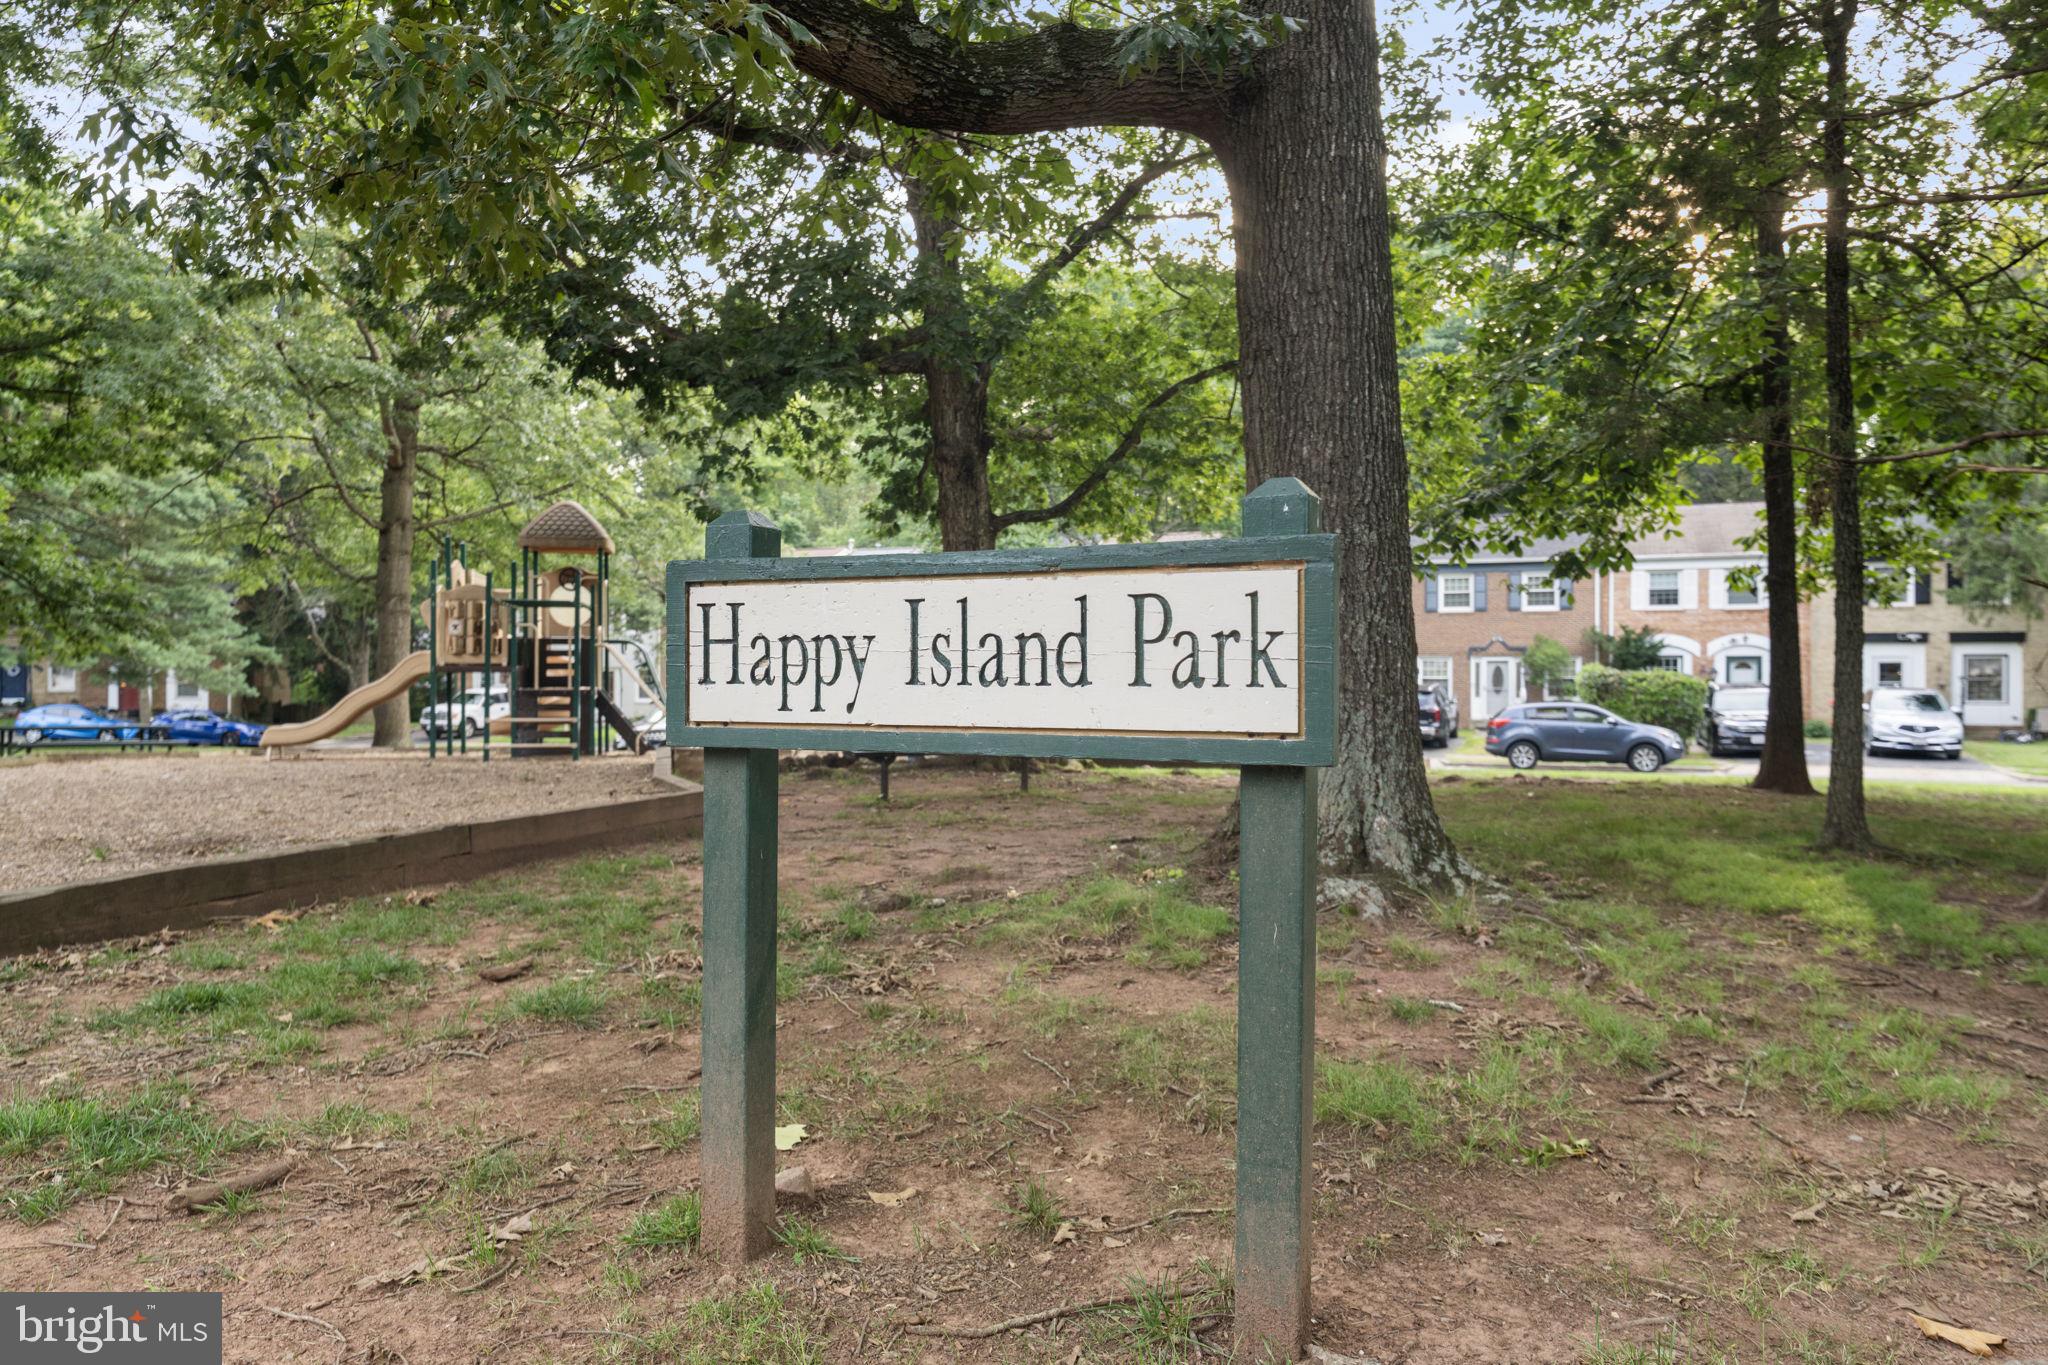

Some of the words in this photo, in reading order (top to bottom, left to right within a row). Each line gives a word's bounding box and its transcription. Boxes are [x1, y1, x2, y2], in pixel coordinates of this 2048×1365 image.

[697, 602, 876, 713] Happy
[905, 595, 1093, 688] Island
[1127, 590, 1288, 689] Park
